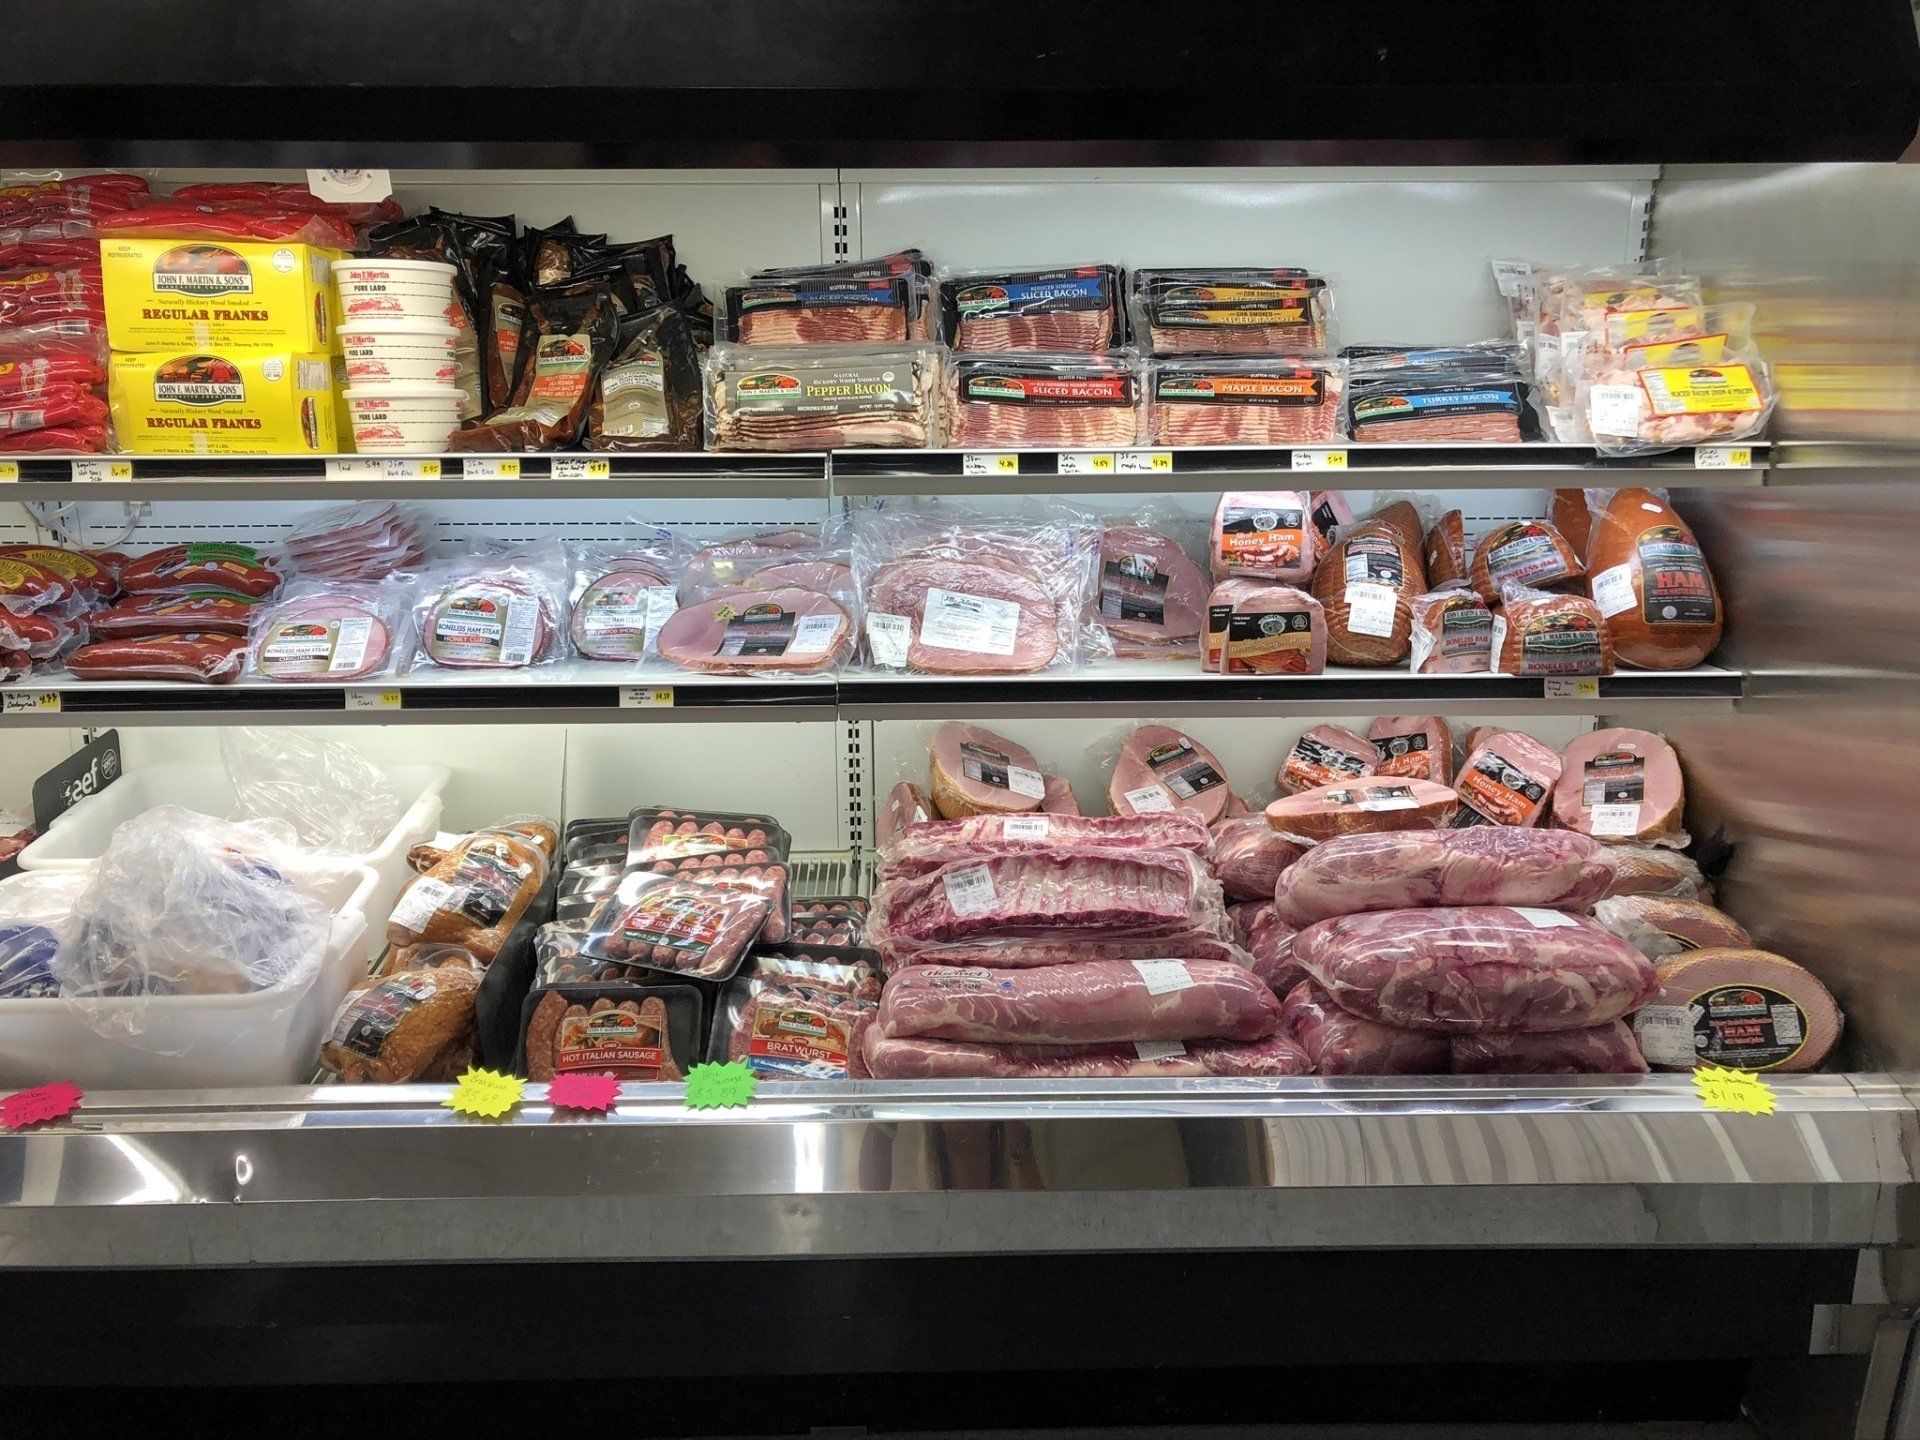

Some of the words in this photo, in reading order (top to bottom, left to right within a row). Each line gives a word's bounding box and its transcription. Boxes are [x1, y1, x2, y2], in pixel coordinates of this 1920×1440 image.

[367, 271, 390, 279] Martin
[158, 275, 177, 284] JOHN
[186, 275, 213, 285] MARTIN
[215, 276, 223, 285] &
[224, 276, 244, 286] SONS
[354, 284, 368, 292] PURE
[369, 284, 387, 292] LARD
[1020, 291, 1051, 300] SLICED
[1054, 288, 1088, 298] BACON
[158, 299, 185, 307] Naturally
[186, 299, 209, 307] Hickory
[143, 308, 209, 321] REGULAR
[213, 309, 269, 321] FRANKS
[356, 336, 376, 344] Martin
[158, 385, 176, 395] JOHN
[184, 386, 210, 395] MARTIN
[211, 387, 218, 395] &
[219, 387, 237, 396] SONS
[806, 385, 851, 397] PEPPER
[854, 383, 891, 396] BACON
[1032, 386, 1069, 395] SLICED
[1072, 387, 1113, 396] BACON
[1222, 385, 1257, 393] MAPLE
[1261, 385, 1303, 394] BACON
[1422, 394, 1459, 405] TURKEY
[1462, 392, 1500, 403] BACON
[368, 400, 390, 408] Martin
[359, 413, 371, 421] PURE
[371, 413, 387, 421] LARD
[146, 417, 209, 429] REGULAR
[211, 418, 262, 429] FRANKS
[1229, 537, 1265, 547] Honey
[1268, 533, 1295, 542] Ham
[1508, 539, 1529, 552] MARTIN
[1497, 564, 1541, 583] BONELESS
[1541, 557, 1560, 570] HAM
[1656, 571, 1707, 589] HAM
[438, 623, 466, 632] BONELESS
[467, 626, 481, 634] HAM
[482, 627, 500, 636] STEAK
[1549, 632, 1573, 641] MARTIN
[1579, 631, 1594, 640] SONS
[1446, 637, 1475, 646] BONELESS
[1527, 662, 1575, 672] BONELESS
[1403, 755, 1423, 765] Ham
[1472, 776, 1502, 797] Honey
[1505, 792, 1527, 809] Ham
[766, 1041, 832, 1060] BRATWURST
[562, 1054, 581, 1063] HOT
[582, 1051, 616, 1061] ITALIAN
[617, 1051, 657, 1061] SAUSAGE
